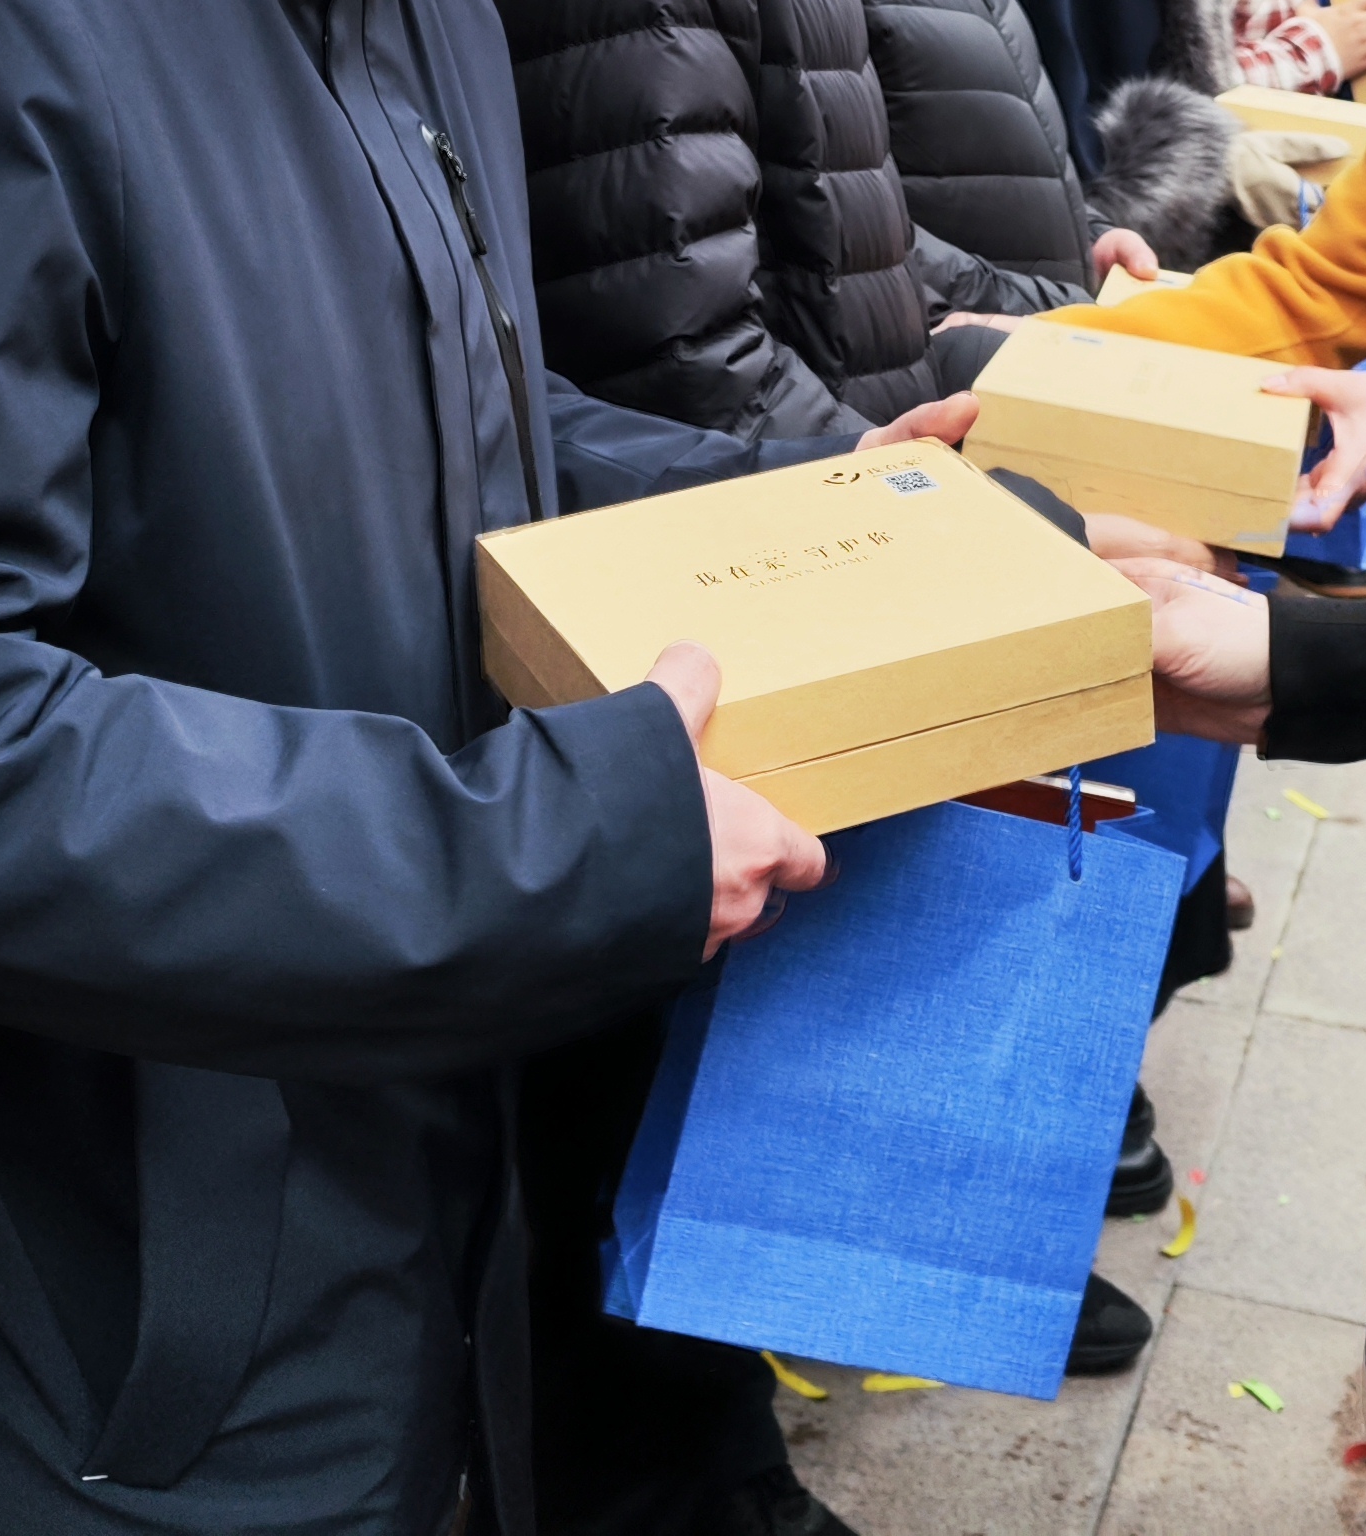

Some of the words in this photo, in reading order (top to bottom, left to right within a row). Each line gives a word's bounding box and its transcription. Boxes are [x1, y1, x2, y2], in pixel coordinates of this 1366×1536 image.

[693, 550, 786, 587] 我在家
[803, 531, 894, 559] 守护你
